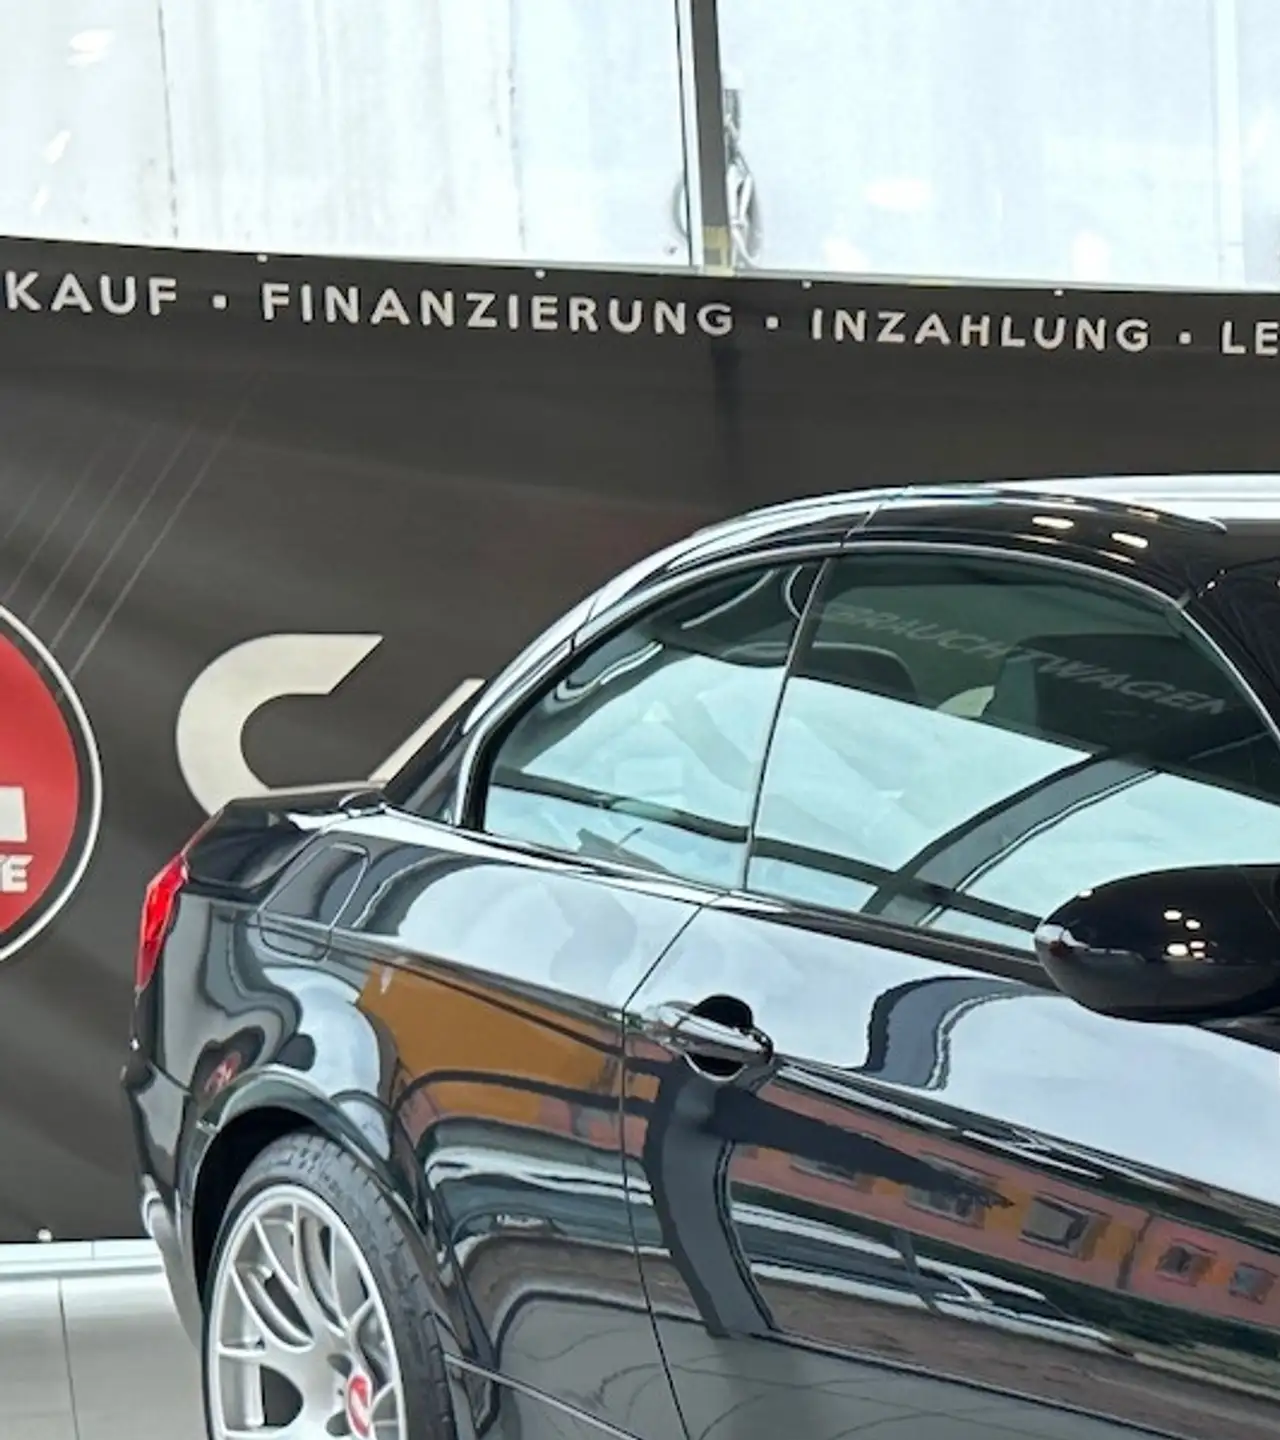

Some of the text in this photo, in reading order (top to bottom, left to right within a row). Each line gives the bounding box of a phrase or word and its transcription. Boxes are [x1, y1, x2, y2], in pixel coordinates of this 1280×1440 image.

[5, 270, 177, 316] KAUF
[262, 282, 733, 338] FINANZIERUNG
[811, 307, 1149, 353] INZAHLUNG
